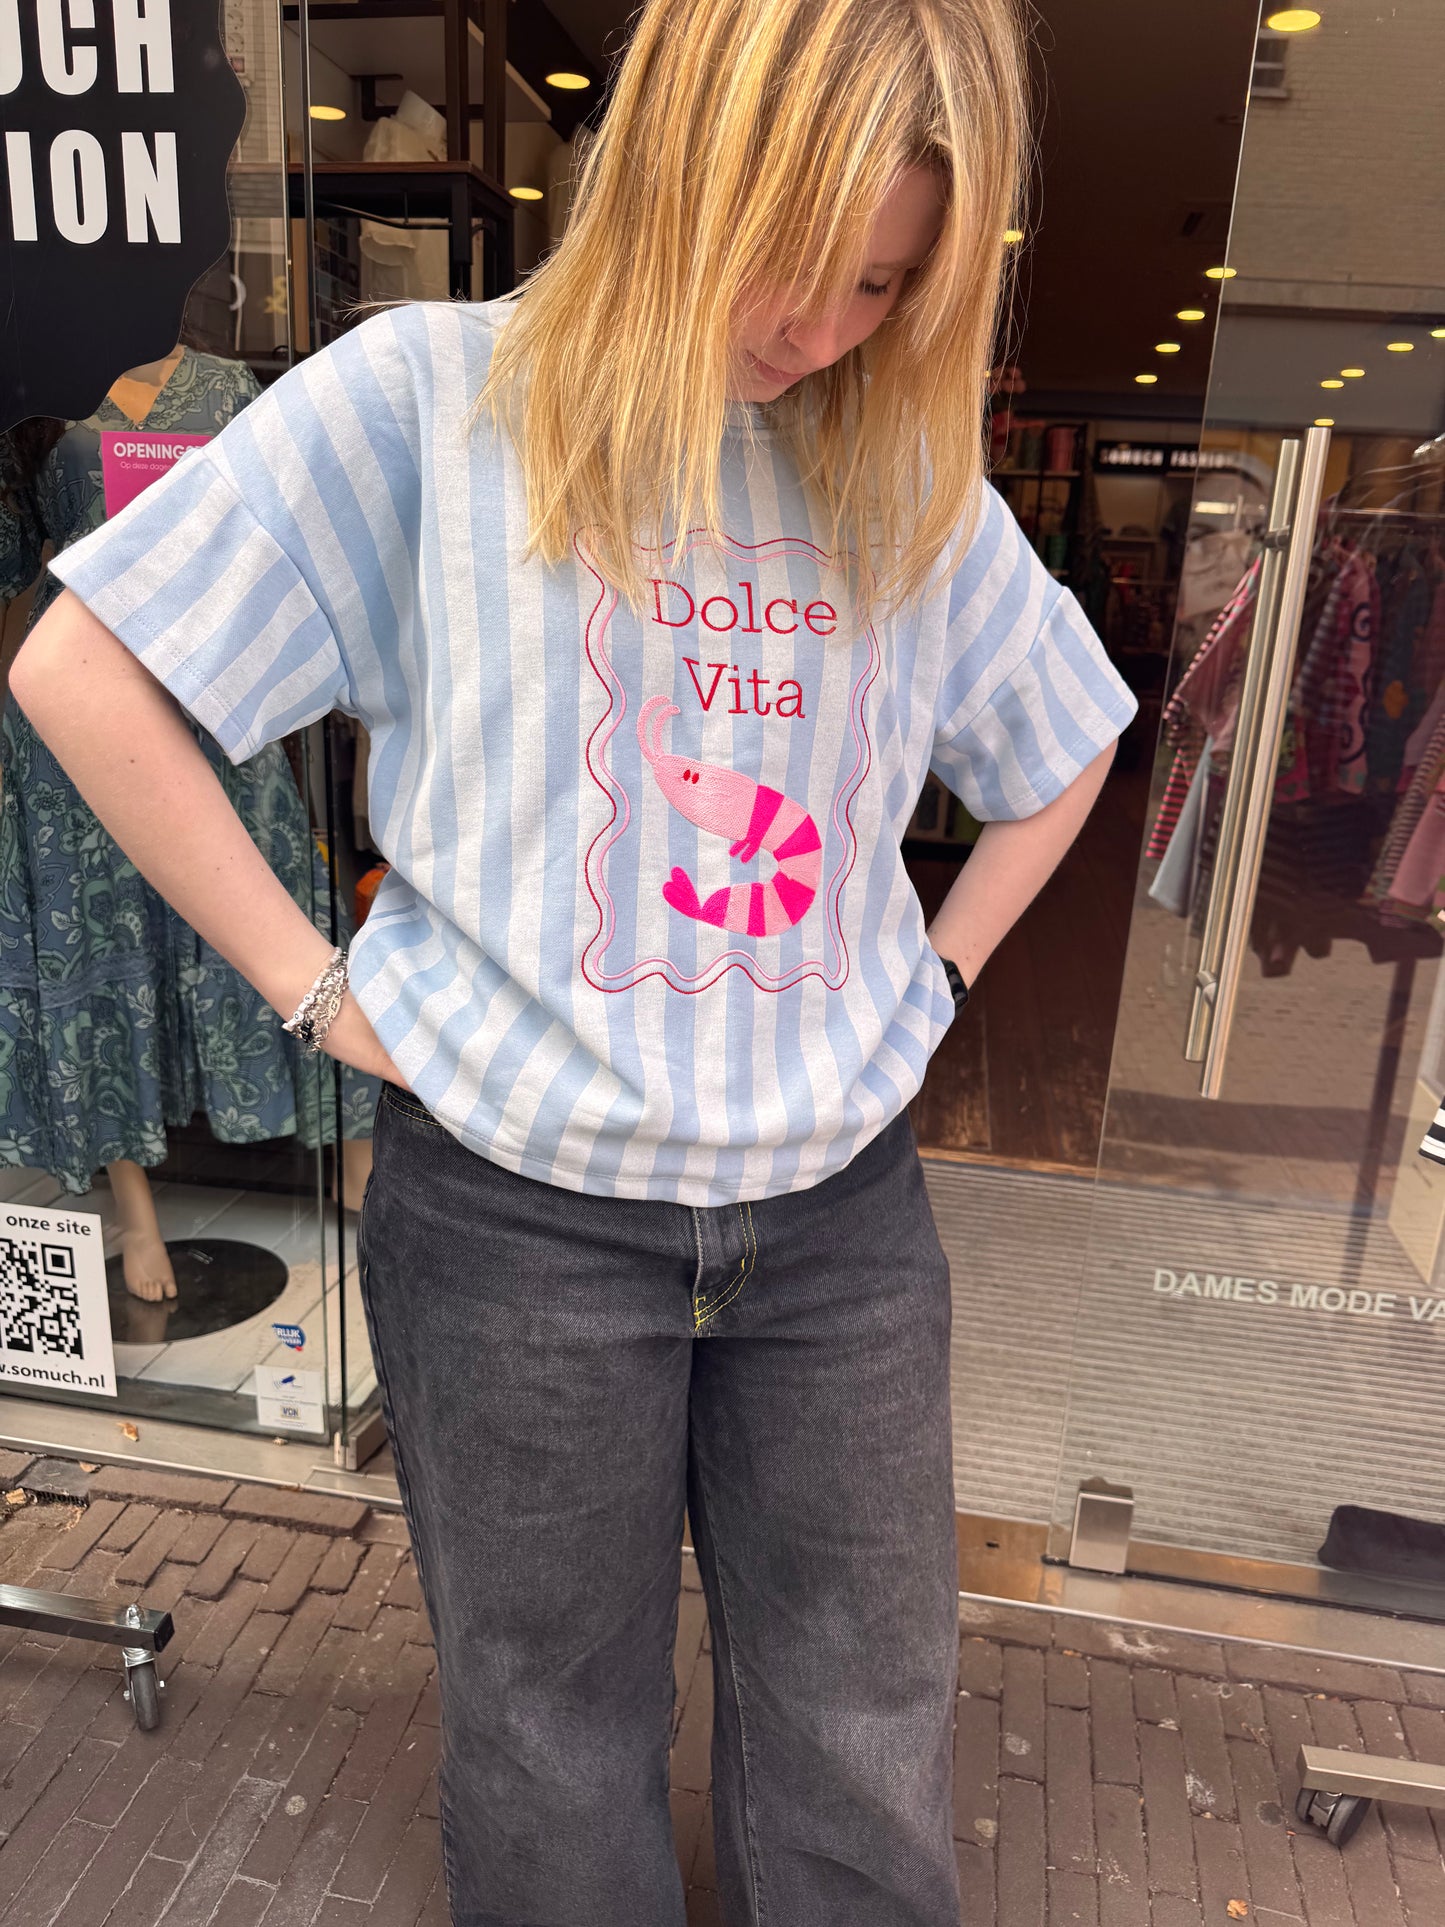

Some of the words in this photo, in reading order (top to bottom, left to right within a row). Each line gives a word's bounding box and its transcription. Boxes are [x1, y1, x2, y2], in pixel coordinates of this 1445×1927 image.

[5, 130, 181, 244] ION
[113, 441, 202, 460] OPENING
[648, 579, 837, 636] Dolce
[682, 657, 805, 718] Vita
[6, 1215, 50, 1230] onze
[57, 1219, 91, 1236] site
[1153, 1268, 1278, 1304] DAMES
[1290, 1284, 1397, 1317] MODE
